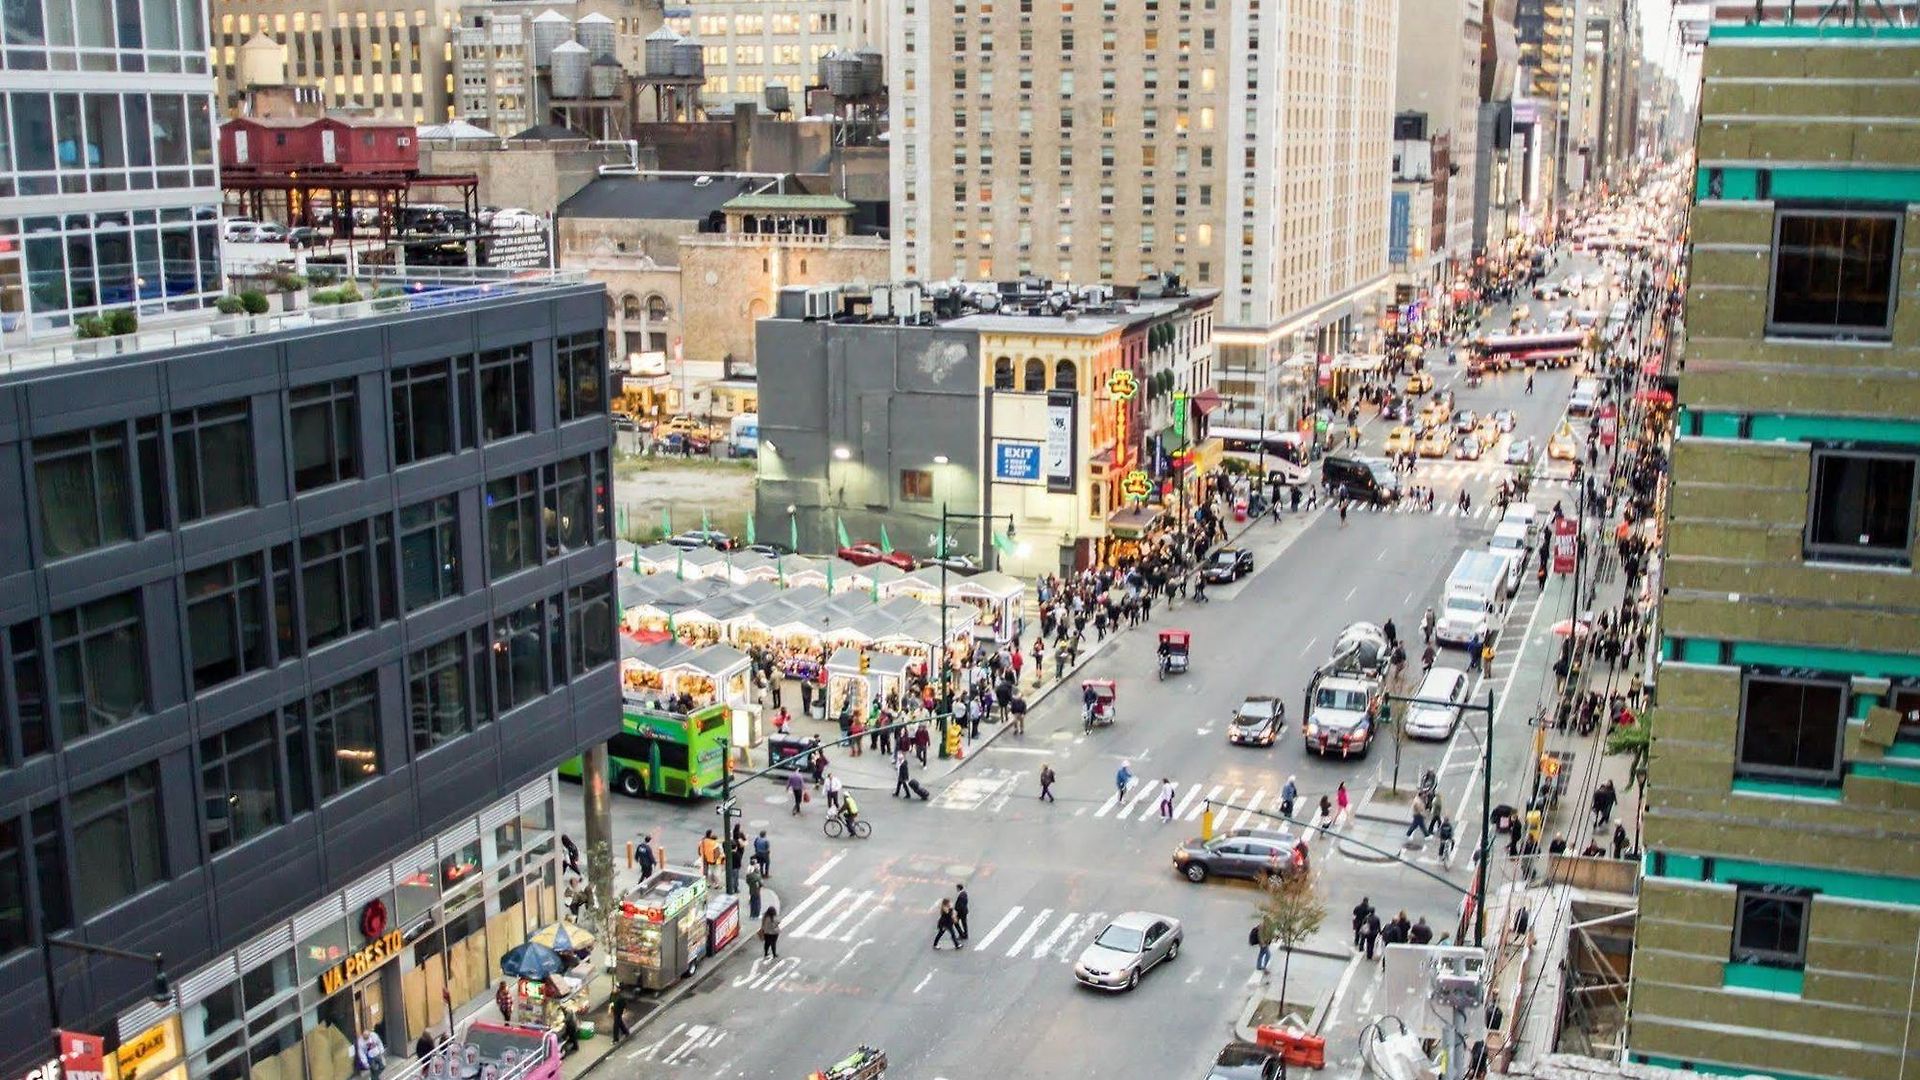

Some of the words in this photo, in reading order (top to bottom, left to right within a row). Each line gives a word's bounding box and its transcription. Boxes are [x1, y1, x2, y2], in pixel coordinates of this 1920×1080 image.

[1004, 446, 1033, 459] EXIT
[323, 966, 345, 995] VA
[345, 930, 402, 982] PRESTO
